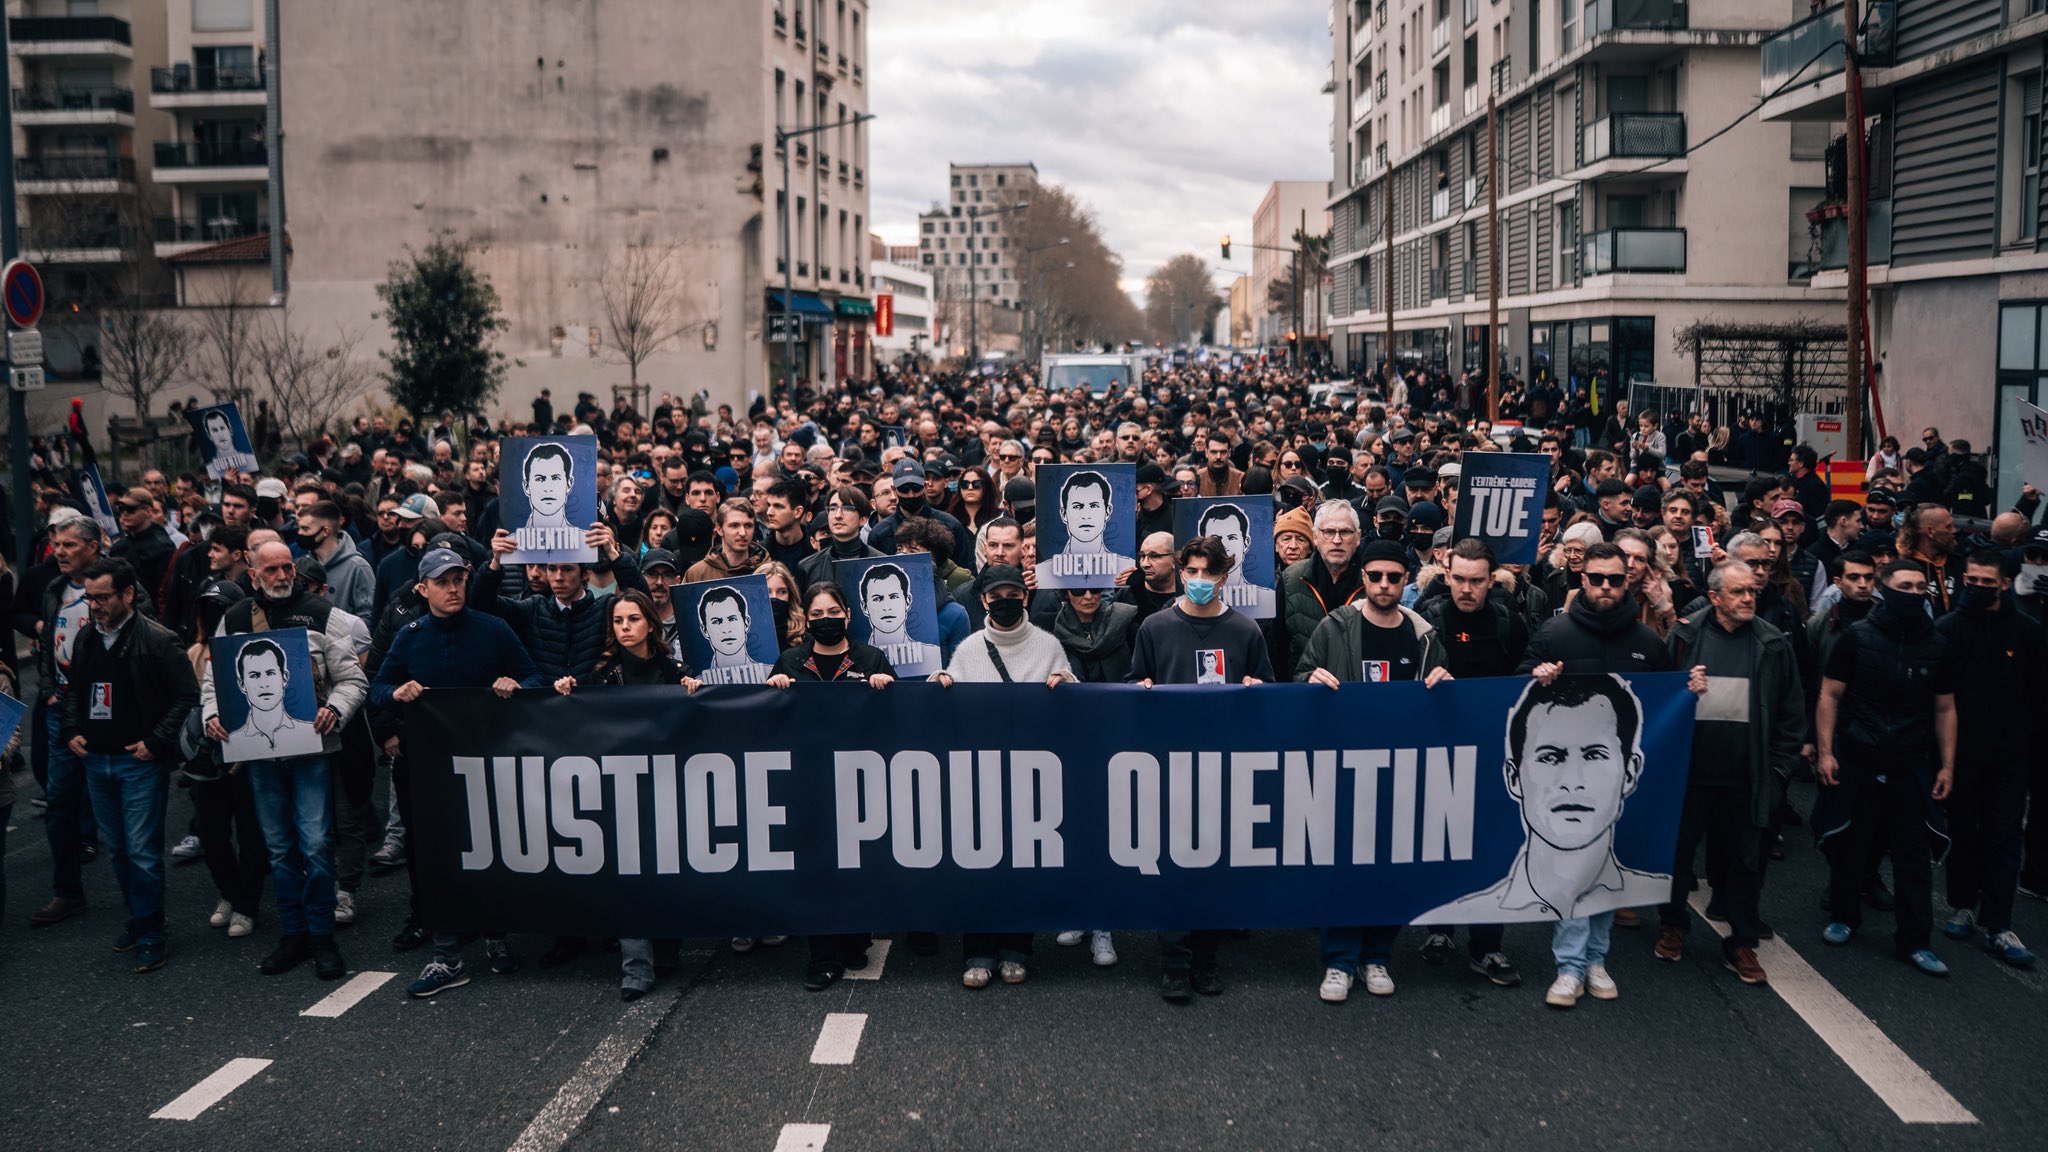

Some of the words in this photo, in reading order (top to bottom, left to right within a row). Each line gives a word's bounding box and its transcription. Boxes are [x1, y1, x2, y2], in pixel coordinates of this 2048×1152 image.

[1471, 475, 1537, 488] L'EXTRÊME-GAUCHE
[1469, 487, 1535, 537] TUE
[516, 527, 580, 552] QUENTIN
[1052, 553, 1118, 577] QUENTIN
[1219, 585, 1258, 607] NTIN
[452, 751, 795, 875] JUSTICE
[834, 750, 1064, 869] POUR
[1107, 745, 1477, 875] QUENTIN
